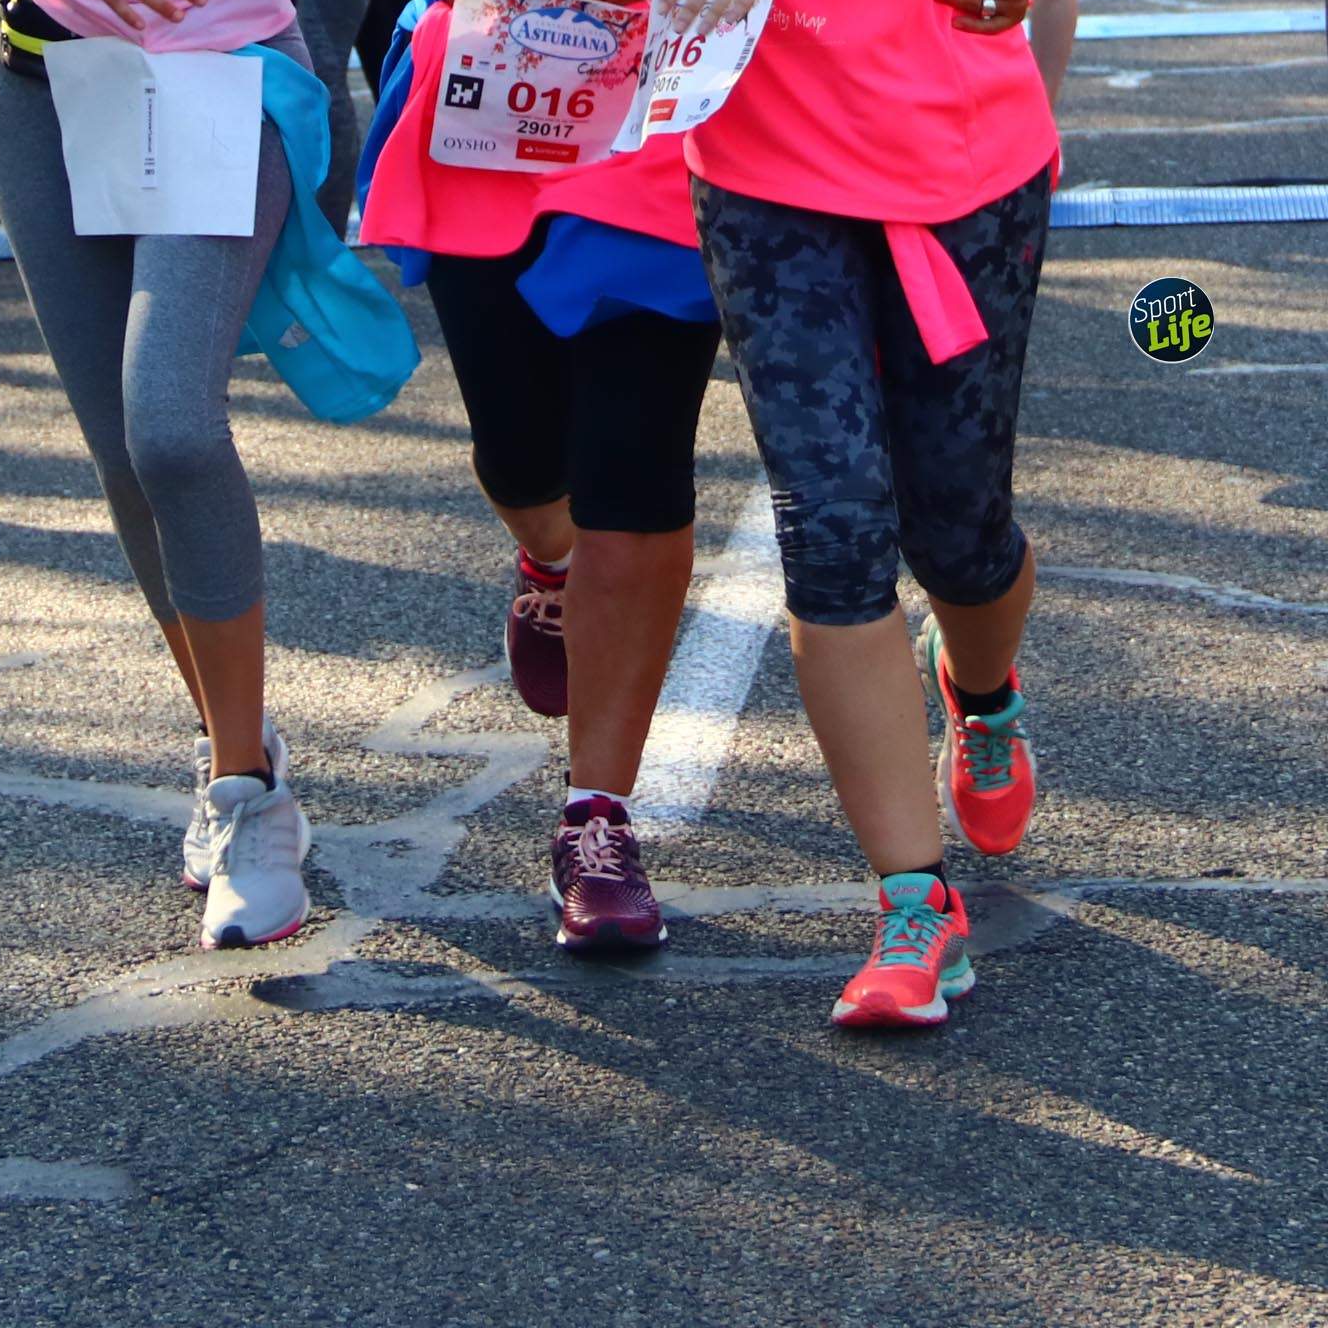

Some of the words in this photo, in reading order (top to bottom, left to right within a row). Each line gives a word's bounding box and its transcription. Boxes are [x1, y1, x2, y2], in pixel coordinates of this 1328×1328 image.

[516, 19, 610, 54] ASTURIANA
[654, 34, 707, 72] 016
[507, 82, 596, 119] 016
[443, 136, 497, 153] OYSHO
[516, 119, 575, 139] 29017
